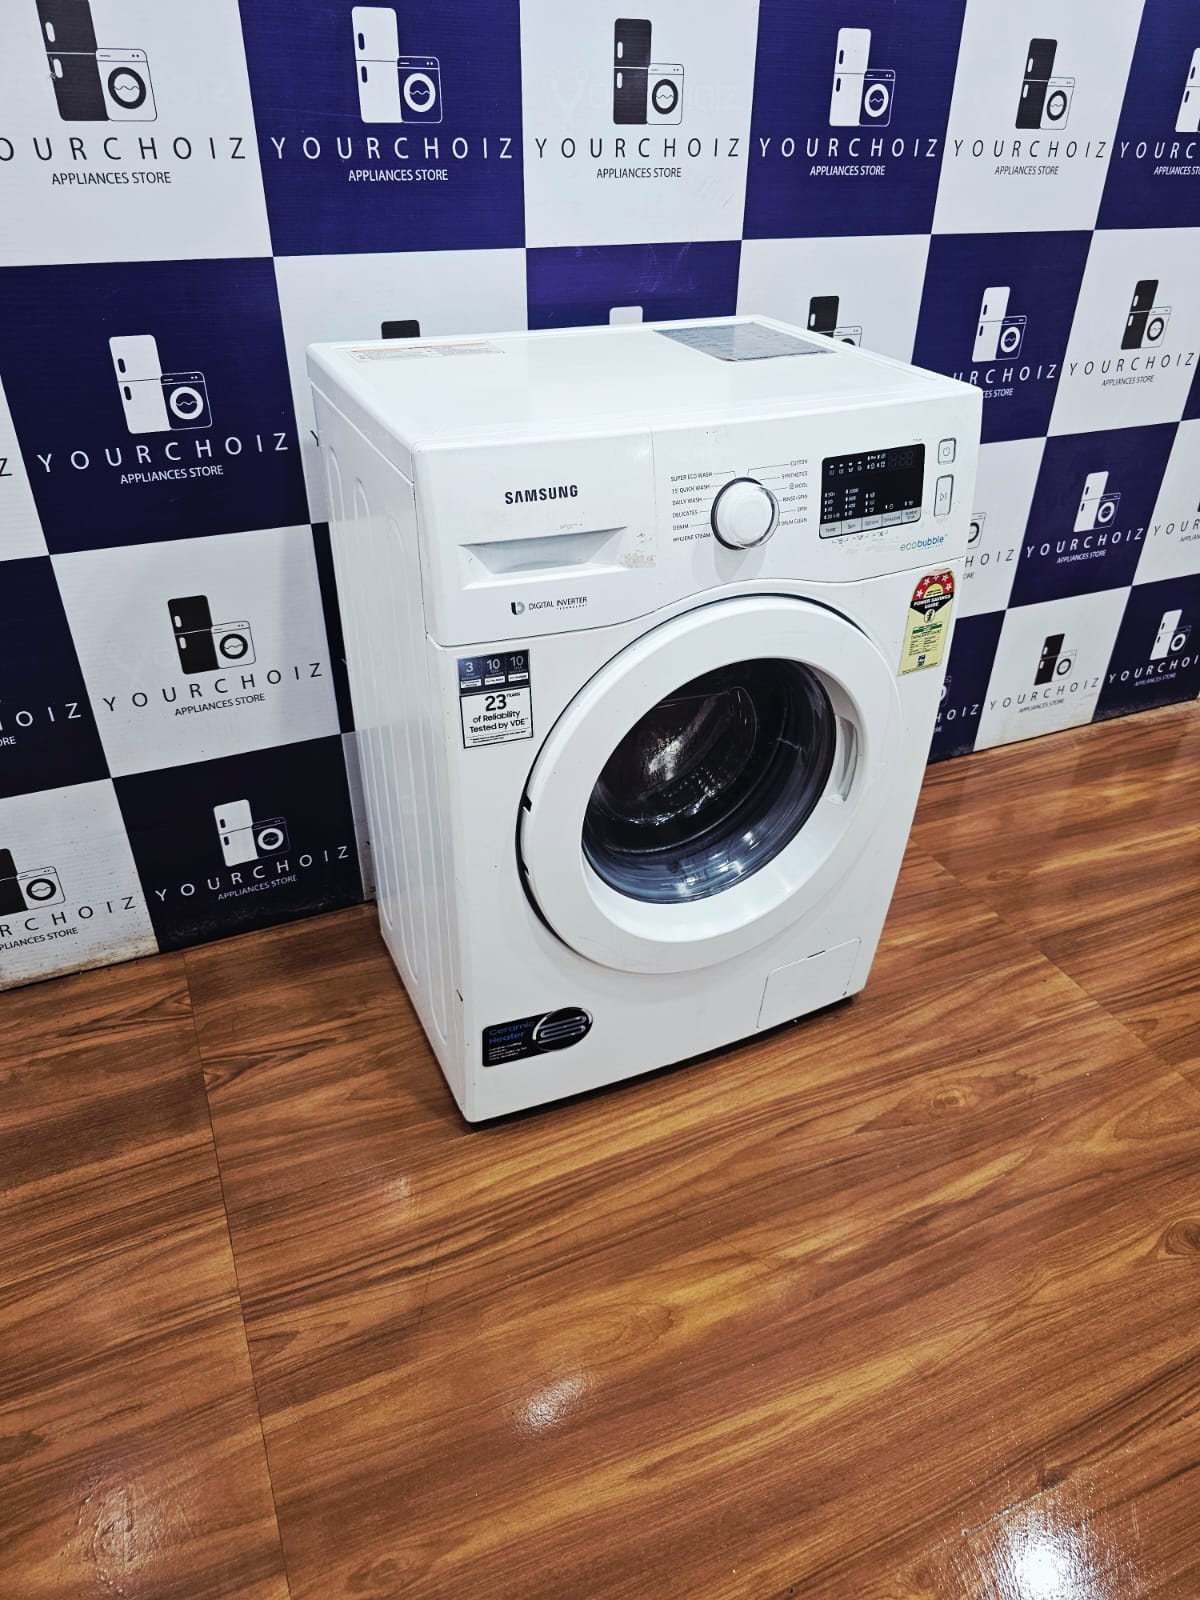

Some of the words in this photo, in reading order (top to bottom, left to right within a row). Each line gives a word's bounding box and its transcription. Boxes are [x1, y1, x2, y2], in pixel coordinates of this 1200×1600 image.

[271, 136, 513, 160] YOURCHOIZ
[535, 137, 741, 160] YOURCHOIZ
[758, 137, 939, 159] YOURCHOIZ
[953, 139, 1107, 159] YOURCHOIZ
[51, 173, 130, 185] APPLIANCES
[131, 171, 172, 184] STORE
[348, 169, 413, 183] APPLIANCES
[415, 168, 449, 182] STORE
[596, 168, 651, 179] APPLIANCES
[653, 167, 682, 179] STORE
[809, 165, 855, 177] APPLIANCES
[856, 164, 886, 176] STORE
[994, 165, 1032, 176] APPLIANCES
[1033, 164, 1059, 176] STORE
[1153, 166, 1191, 175] APPLIANCES
[1070, 352, 1194, 377] YOURCHOIZ
[36, 431, 289, 473] YOURCHOIZ
[120, 469, 189, 485] APPLIANCES
[189, 464, 224, 479] STORE
[504, 484, 579, 505] SAMSUNG
[900, 536, 945, 551] ecobubble
[1026, 528, 1144, 559] YOURCHOIZ
[528, 601, 555, 611] DIGITAL
[556, 596, 588, 607] INVERTER
[465, 661, 474, 673] 3
[486, 658, 501, 670] 10
[510, 655, 524, 668] 10
[103, 662, 323, 712] YOURCHOIZ
[990, 677, 1100, 711] YOURCHOIZ
[174, 696, 233, 717] APPLIANCES
[234, 692, 266, 707] STORE
[484, 694, 507, 712] 23
[0, 703, 82, 731] OIZ
[472, 715, 481, 723] of
[482, 710, 521, 722] Reliability
[469, 723, 497, 734] Tested
[498, 721, 509, 730] by
[510, 718, 525, 727] VDE
[155, 846, 349, 902] YOURCHOIZ
[217, 881, 270, 900] APPLIANCES
[270, 874, 298, 889] STORE
[48, 926, 79, 941] STORE
[489, 1020, 535, 1036] Ceramic
[489, 1031, 526, 1044] Heater
